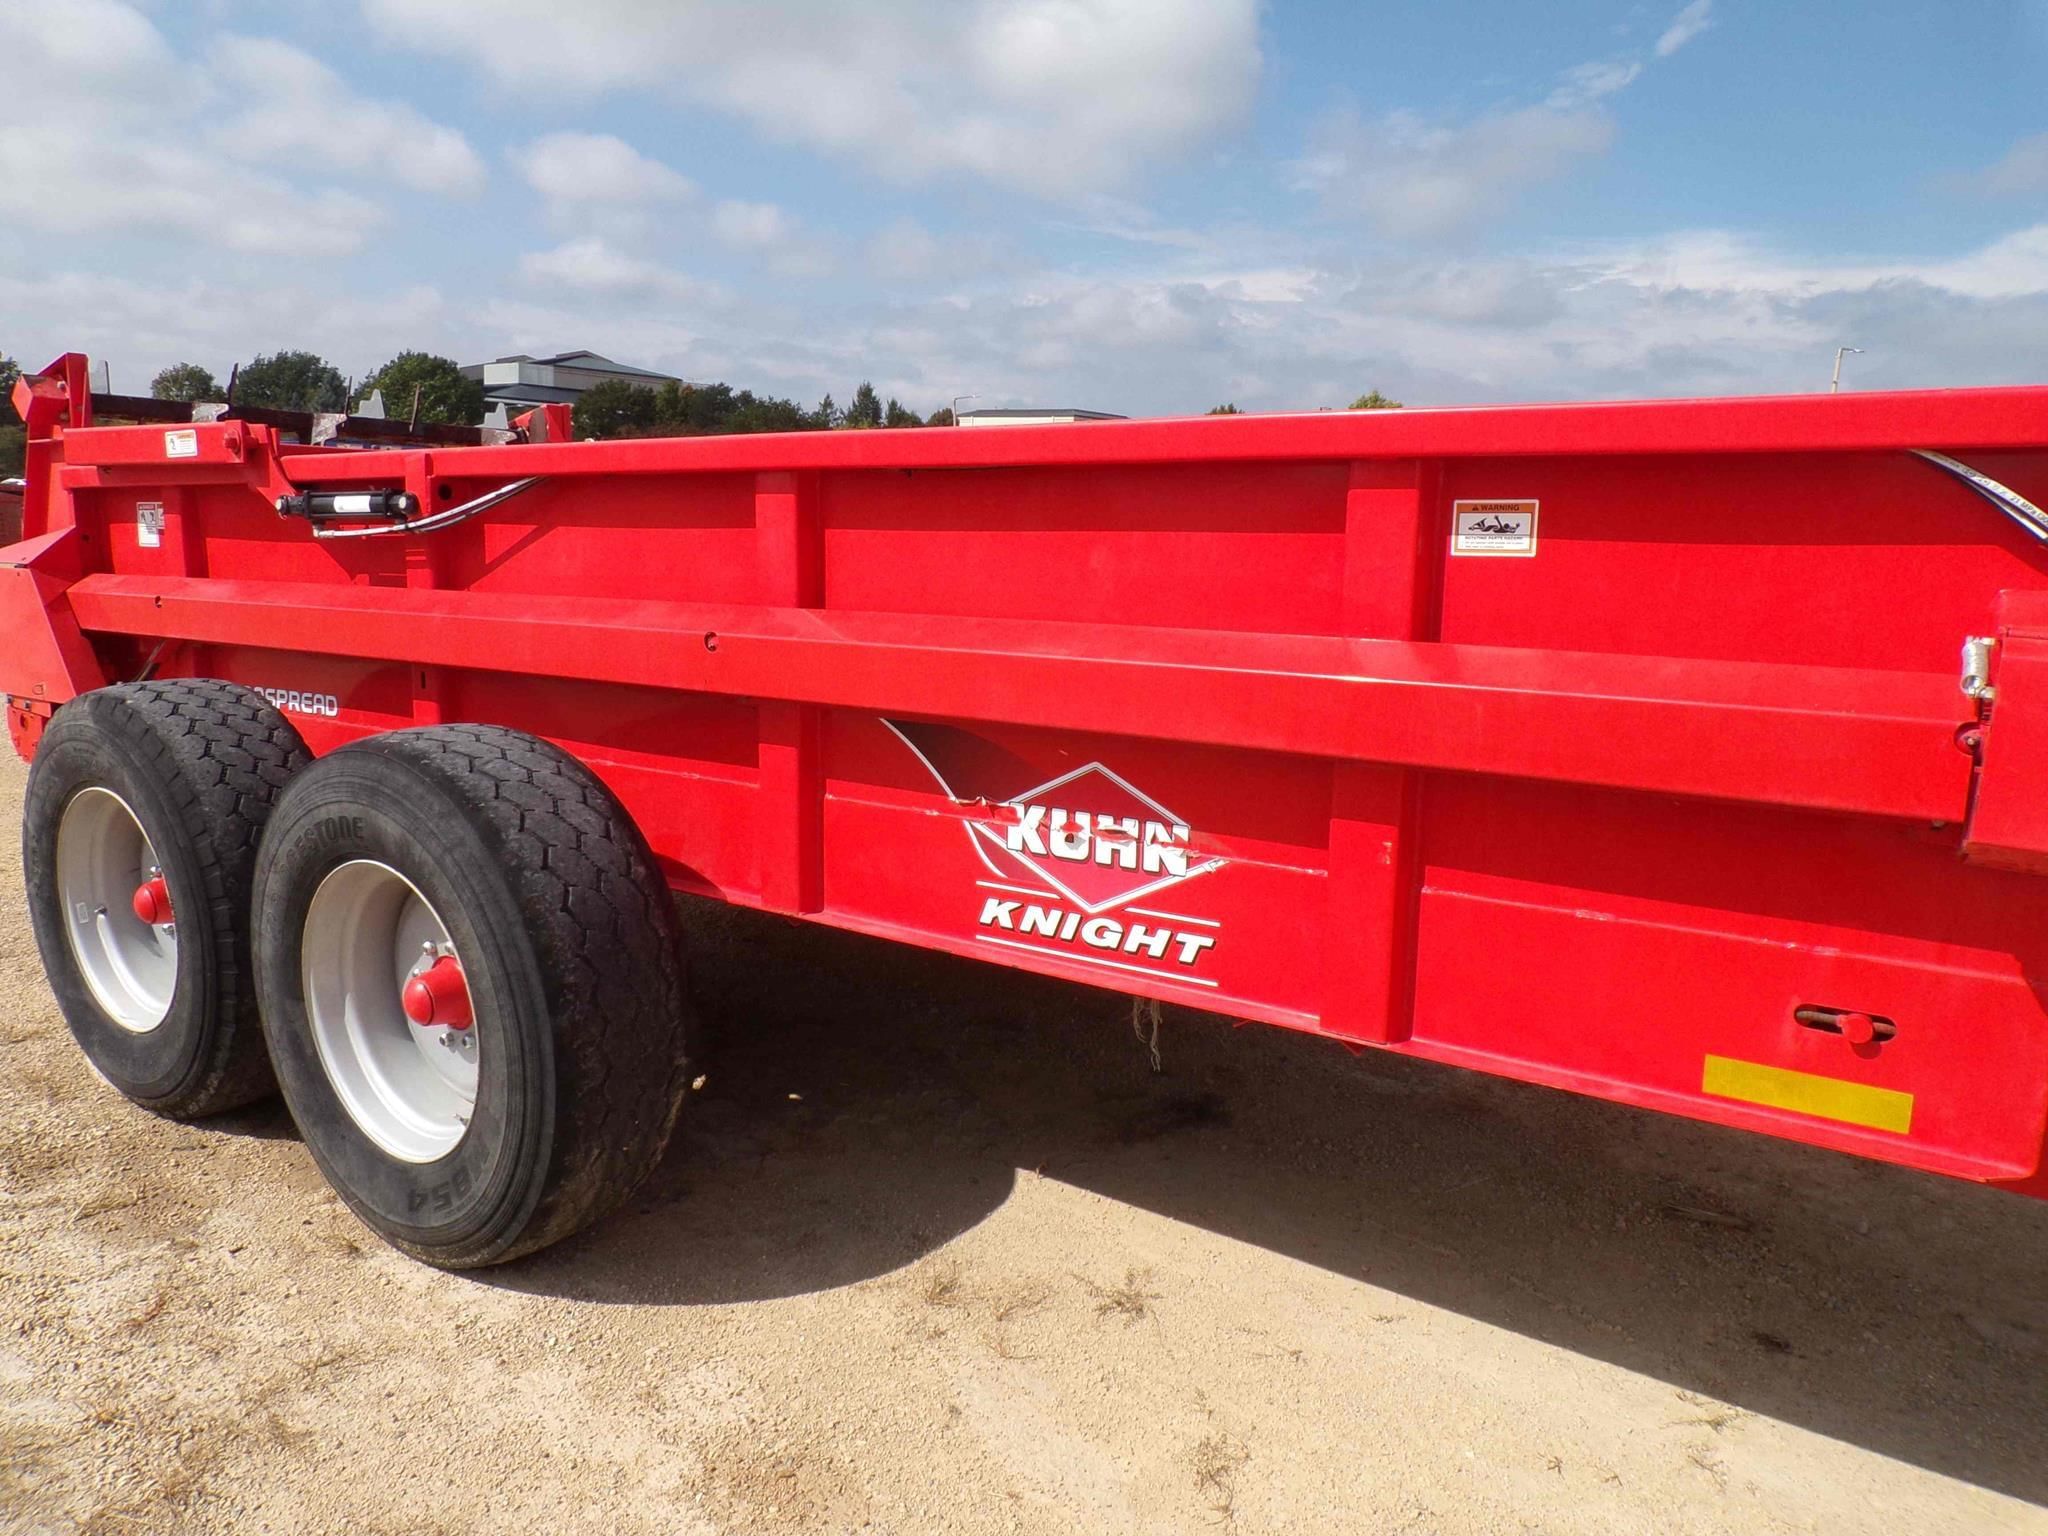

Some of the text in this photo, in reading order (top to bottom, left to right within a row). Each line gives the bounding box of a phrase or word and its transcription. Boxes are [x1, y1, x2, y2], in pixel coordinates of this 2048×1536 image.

[1480, 503, 1520, 511] WARNING
[244, 686, 338, 716] SPREAD
[1006, 801, 1190, 877] KUHN
[979, 897, 1216, 964] KNIGHT
